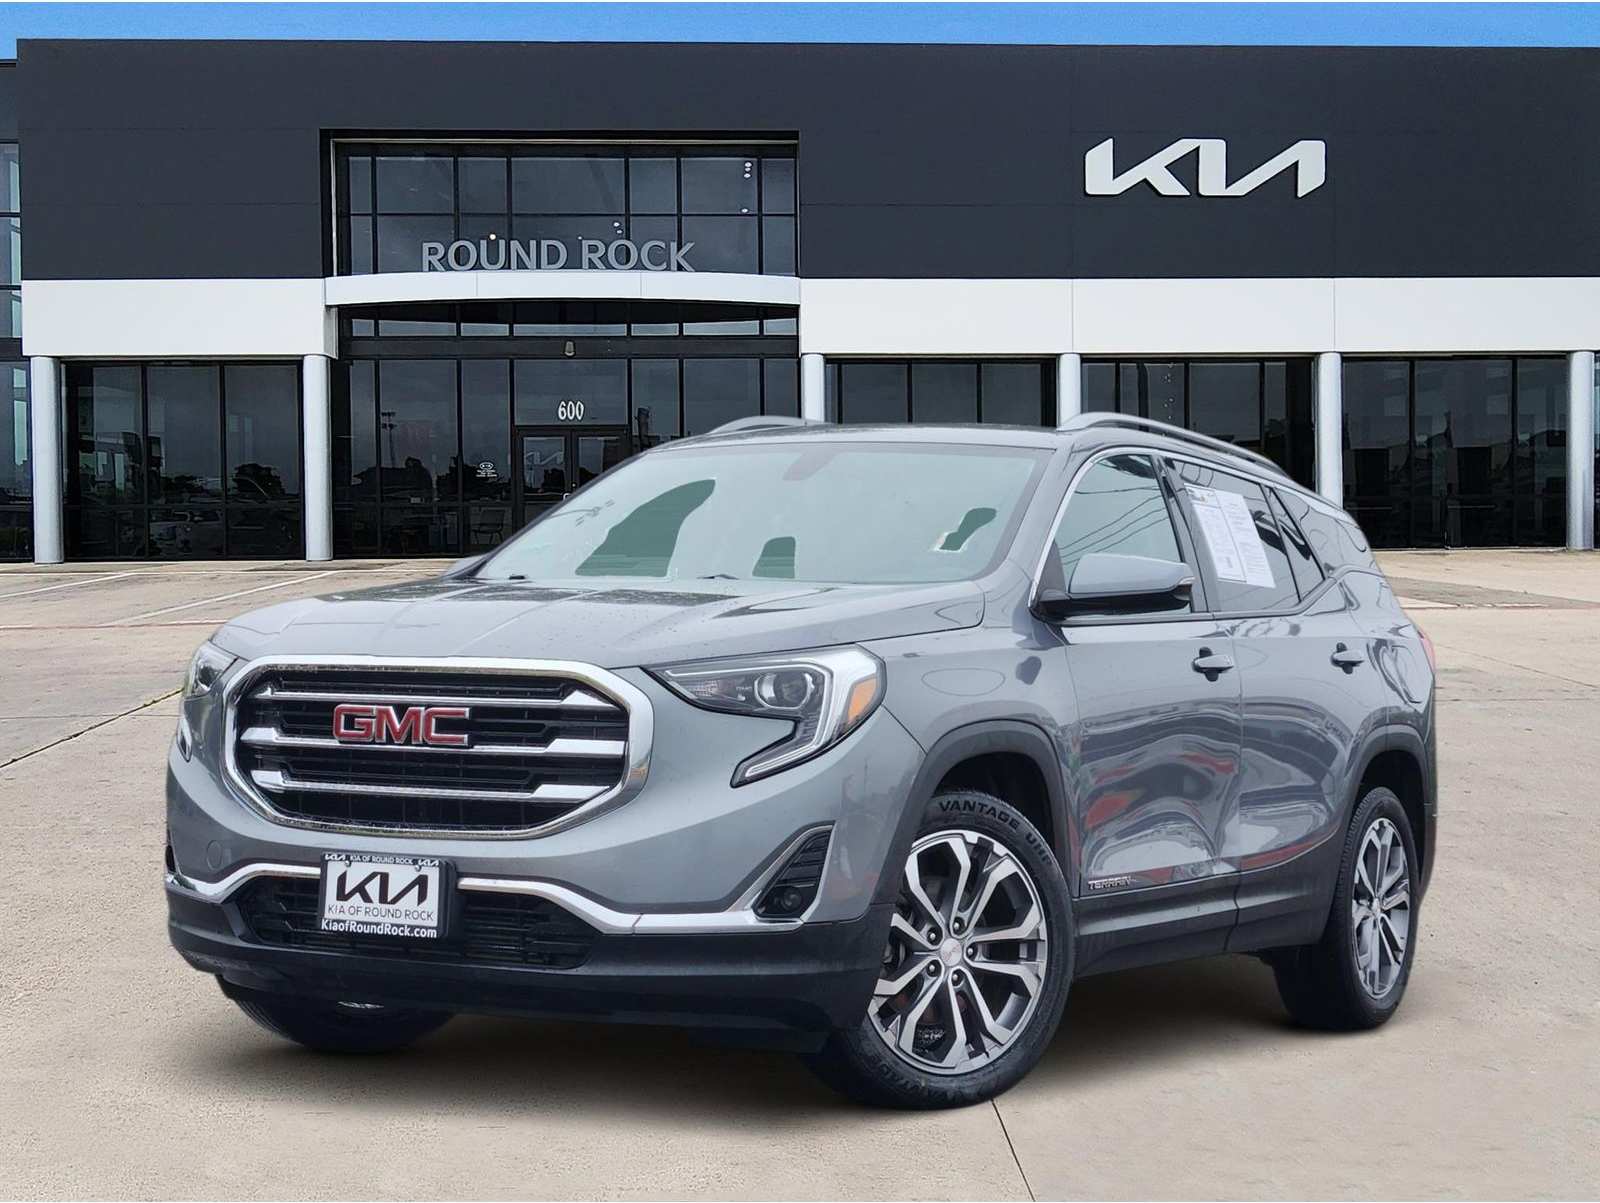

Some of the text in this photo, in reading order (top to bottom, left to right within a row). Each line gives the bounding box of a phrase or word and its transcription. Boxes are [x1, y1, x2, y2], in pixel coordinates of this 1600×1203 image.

[1085, 138, 1326, 198] KIA
[422, 239, 695, 272] ROUND ROCK
[558, 401, 584, 420] 600
[333, 704, 470, 746] GMC
[939, 800, 1020, 830] VANTAGE
[336, 870, 428, 906] KIA
[321, 919, 437, 938] KiaofRoundRock.com
[328, 905, 434, 921] KIA OF ROUND ROCK
